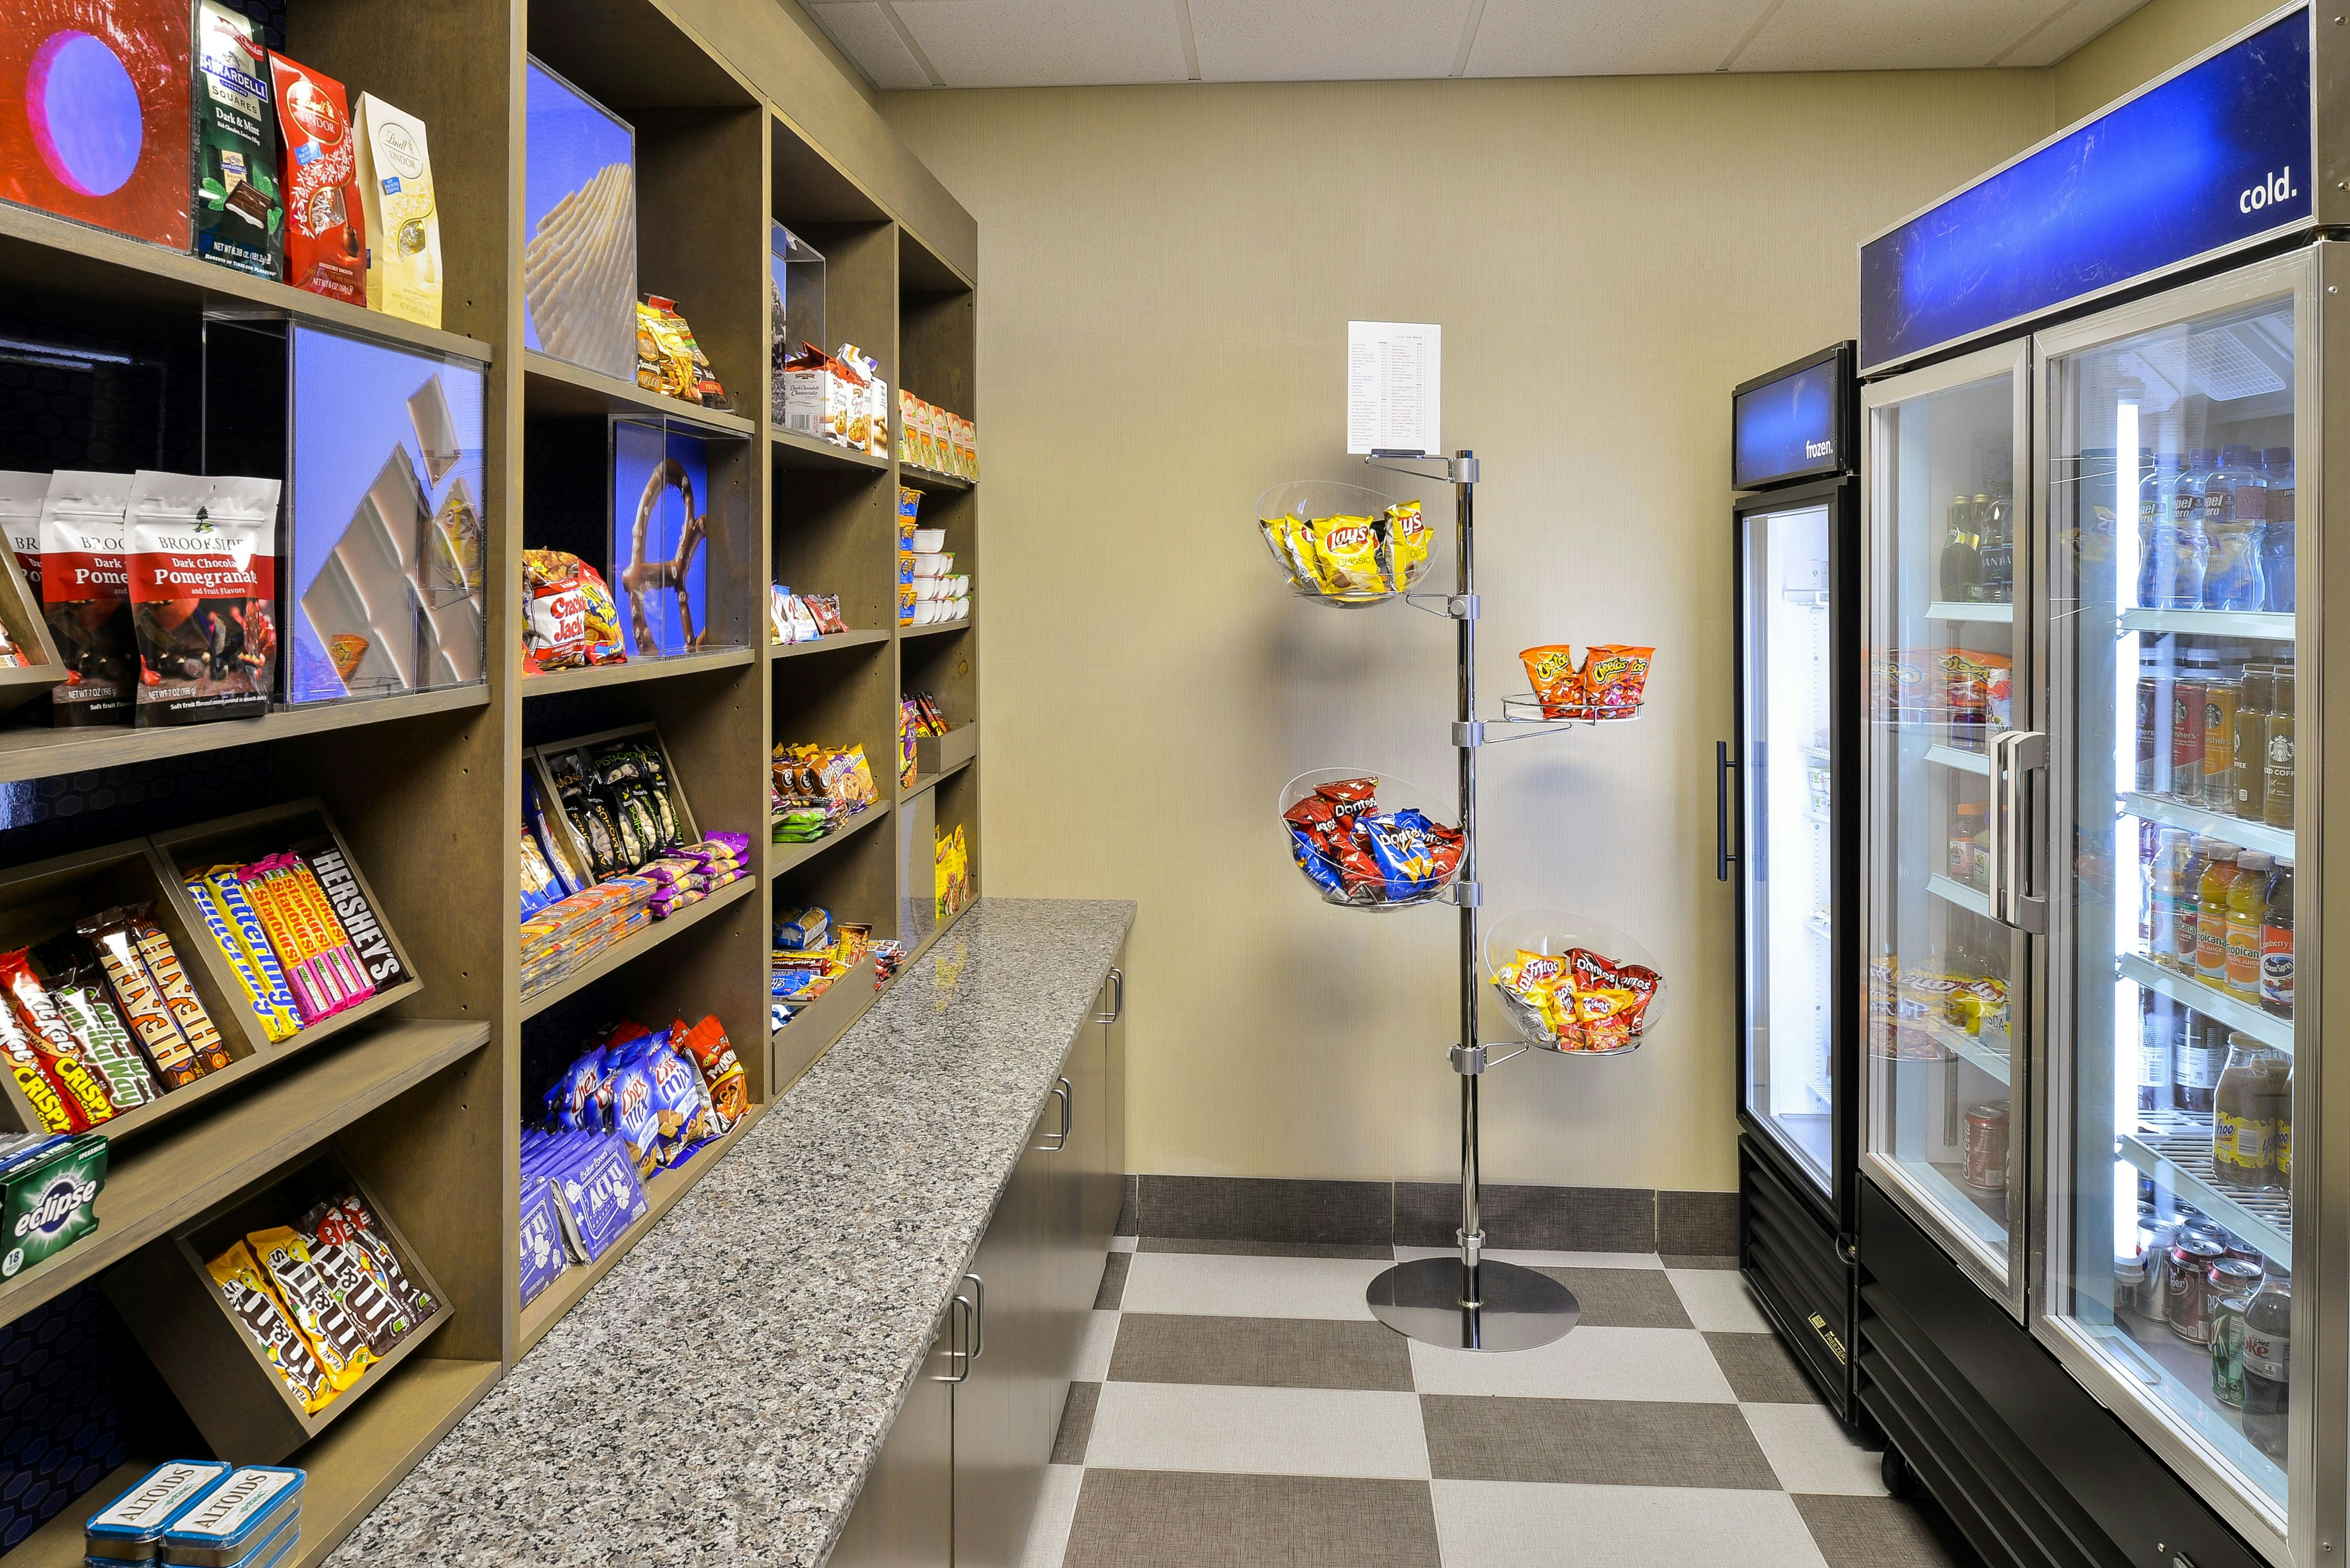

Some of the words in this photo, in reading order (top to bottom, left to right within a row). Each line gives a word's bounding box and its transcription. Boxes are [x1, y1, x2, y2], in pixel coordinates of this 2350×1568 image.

[212, 86, 257, 114] SQUARES
[215, 107, 235, 125] Dark
[236, 116, 243, 128] &
[244, 119, 259, 136] Mint
[300, 111, 335, 134] LINDOR
[386, 131, 408, 151] Lindt
[389, 149, 416, 169] LINDOR
[2240, 166, 2297, 214] cold.
[213, 241, 224, 251] NET
[224, 244, 232, 254] WT
[1806, 440, 1833, 459] frozen.
[1330, 526, 1369, 550] Lay's
[94, 558, 122, 568] Dark
[171, 558, 196, 568] Dark
[1337, 555, 1371, 567] Classic
[554, 615, 583, 642] Jack
[1592, 657, 1630, 684] Cheetos
[68, 690, 78, 699] NET
[78, 689, 88, 698] WT
[148, 690, 158, 699] NET
[159, 689, 168, 698] WT
[172, 688, 181, 697] OZ
[1336, 797, 1377, 817] Doritos
[270, 880, 319, 954] Starburst
[282, 878, 333, 949] Starburst
[301, 872, 348, 942] Starburst
[313, 851, 400, 980] HERSHEY'S
[253, 889, 303, 964] Starburst
[314, 957, 326, 973] WIN
[328, 951, 341, 965] WIN
[345, 946, 357, 960] WIN
[299, 967, 311, 982] WIN
[1576, 958, 1615, 987] Doritos
[2264, 961, 2277, 972] Ocean
[2277, 960, 2294, 973] Spray
[136, 933, 222, 1053] HEATH
[101, 946, 194, 1073] HEATH
[28, 1036, 50, 1053] Wafers
[54, 1056, 113, 1120] CRISPY
[63, 1081, 76, 1094] Twice
[102, 1057, 145, 1108] Way
[571, 1061, 598, 1115] Chex
[621, 1069, 647, 1116] Chex
[661, 1066, 693, 1103] mix
[13, 1067, 71, 1132] CRISPY
[626, 1099, 649, 1135] mix
[78, 1143, 106, 1160] SPEARMINT
[580, 1162, 595, 1182] Butter
[38, 1178, 58, 1204] INCREDIBLY
[589, 1173, 614, 1215] ACT
[609, 1161, 625, 1181] II
[15, 1180, 97, 1237] eclipse
[6, 1262, 20, 1273] PIECES
[9, 1250, 20, 1266] 18
[1824, 1333, 1845, 1359] FREEZER
[2252, 1334, 2270, 1347] Diet
[118, 1467, 195, 1522] ALTOIDS
[192, 1473, 268, 1530] ALTOIDS
